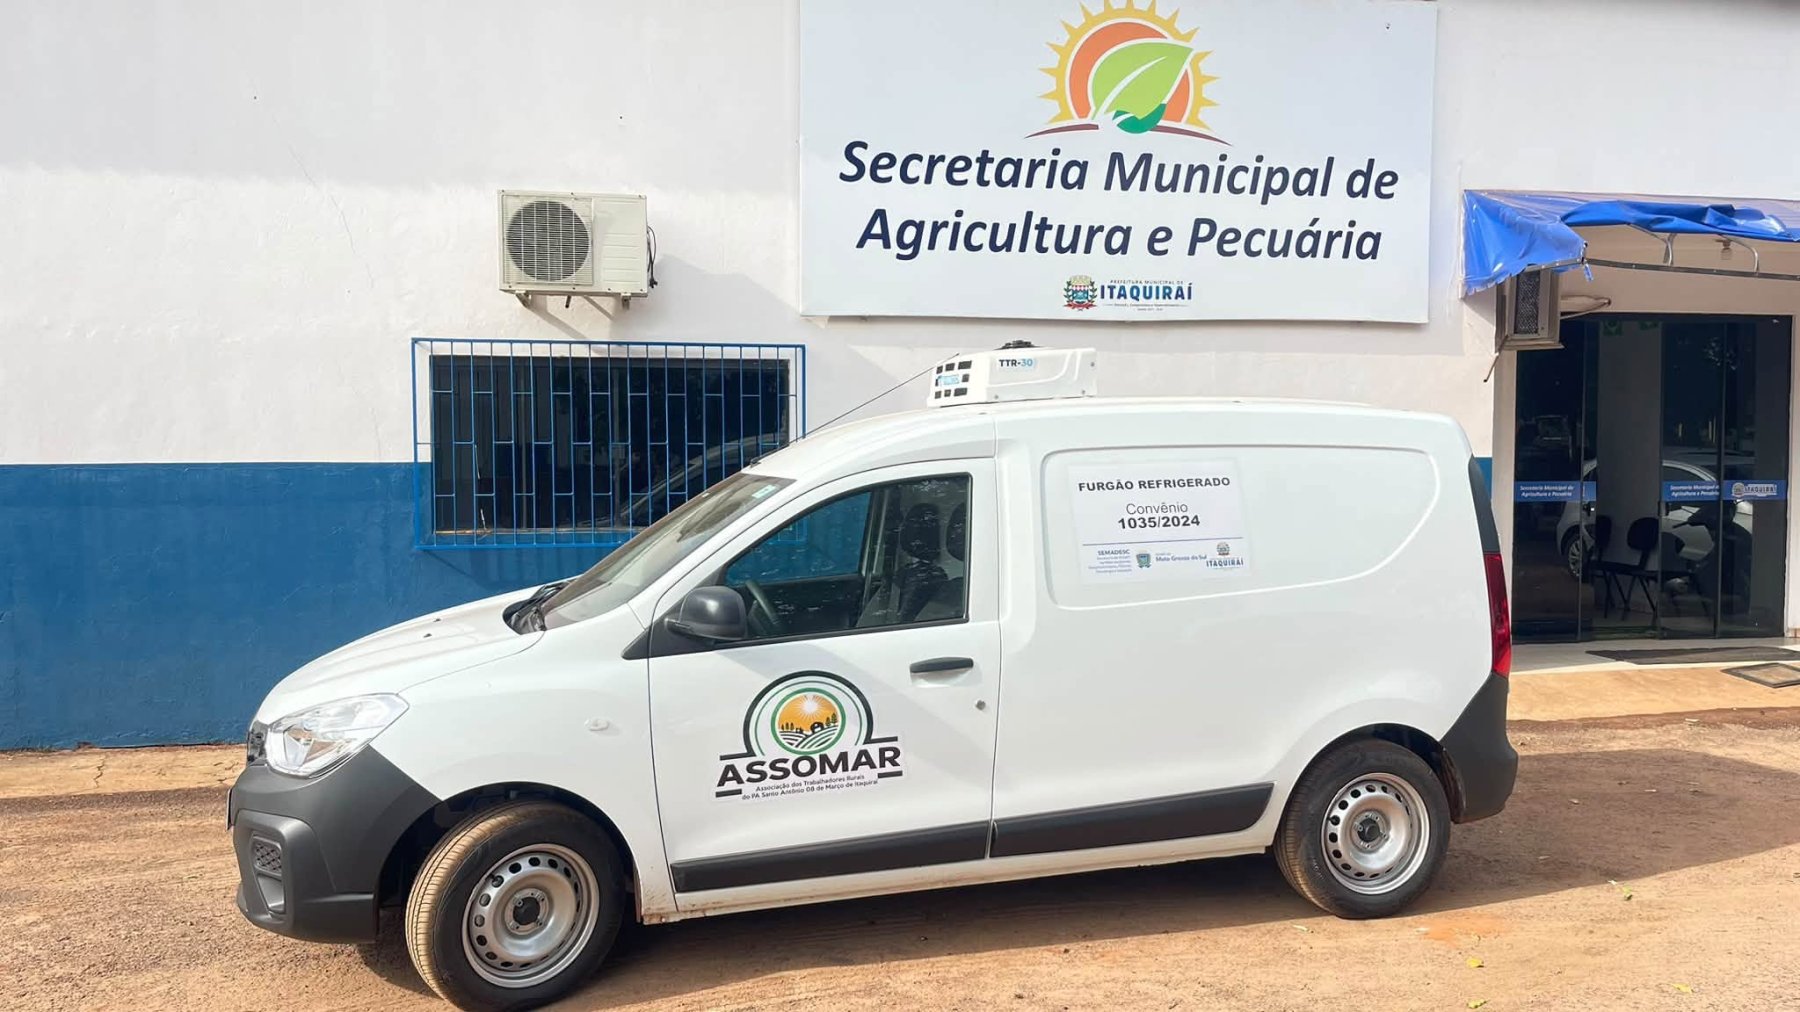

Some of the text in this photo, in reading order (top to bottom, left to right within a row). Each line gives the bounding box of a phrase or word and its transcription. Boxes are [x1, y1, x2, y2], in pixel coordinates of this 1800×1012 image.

[838, 141, 1399, 205] Secretaria Municipal de
[856, 208, 1382, 261] Agricultura e Pecuária
[1100, 282, 1193, 301] ITAQUIRAÍ
[999, 358, 1033, 367] TTR-30
[1078, 477, 1231, 491] FURGÃO REFRIGERADO
[1126, 501, 1188, 515] Convênio
[1118, 515, 1200, 529] 1035/2024
[717, 746, 901, 787] ASSOMAR
[756, 783, 790, 792] Associação
[804, 777, 846, 786] Trabalhadores
